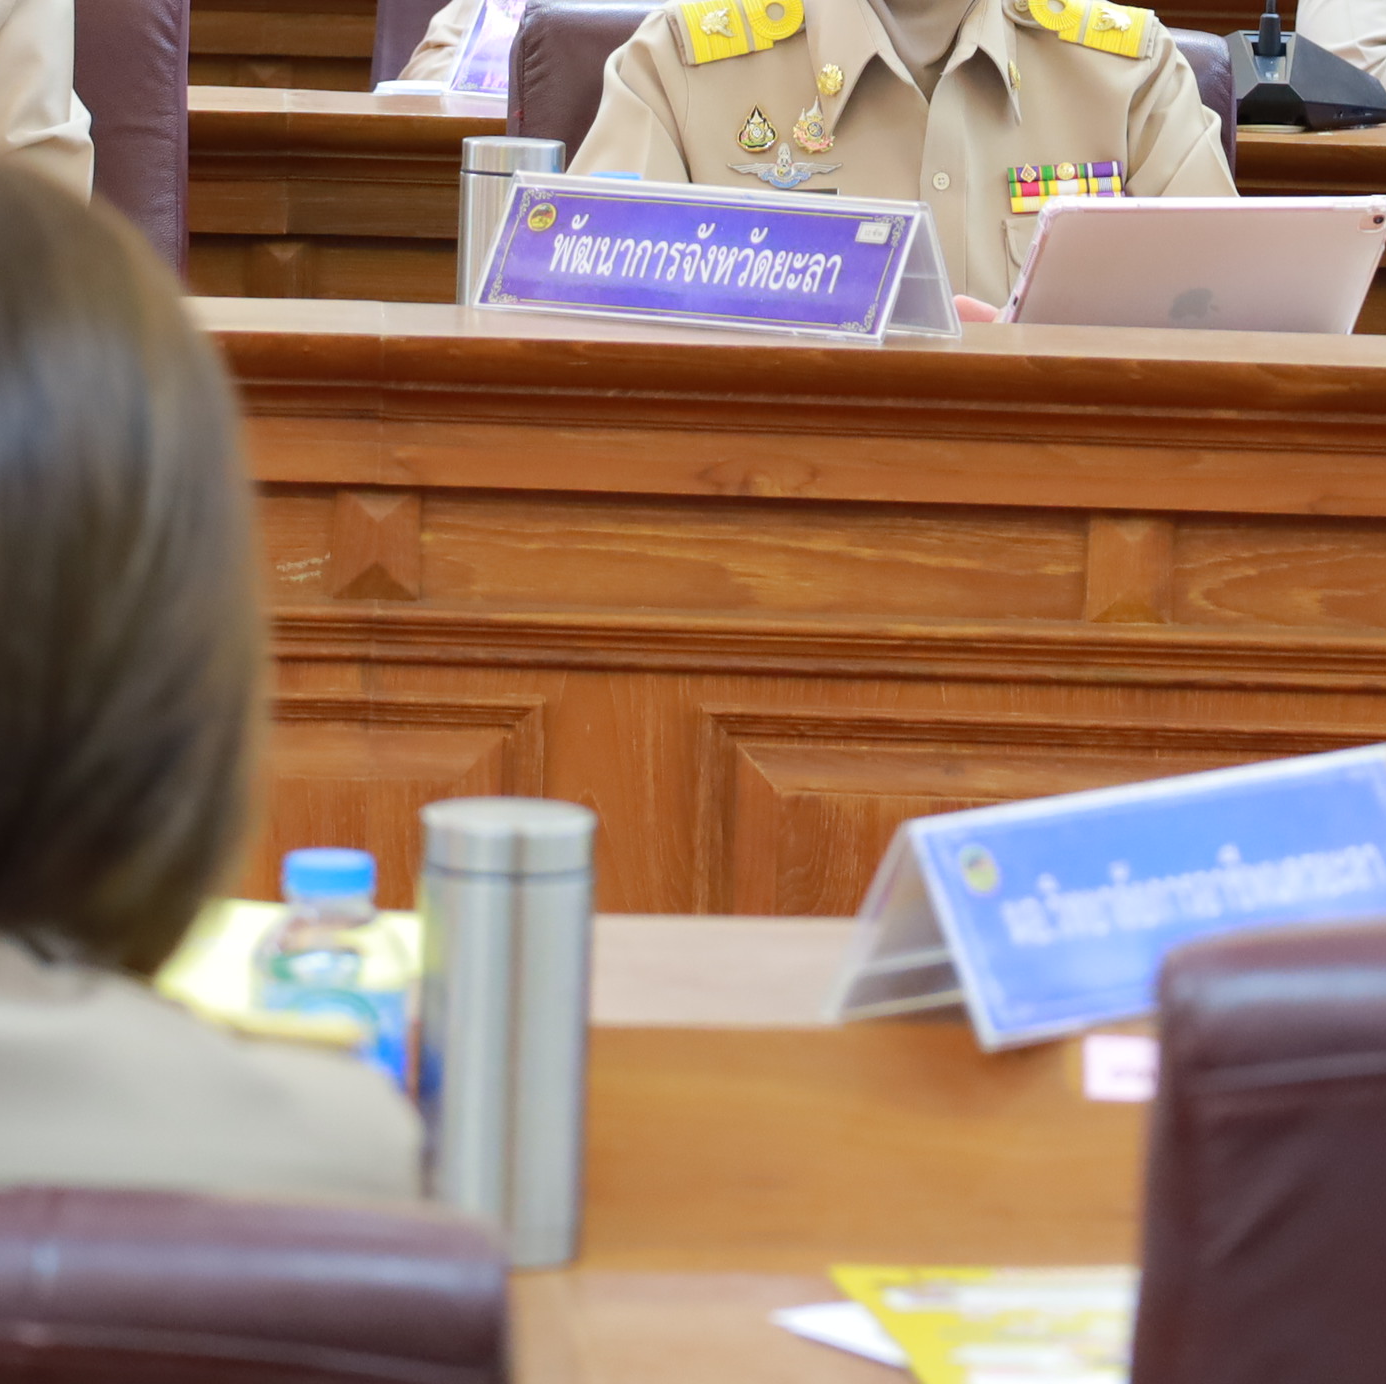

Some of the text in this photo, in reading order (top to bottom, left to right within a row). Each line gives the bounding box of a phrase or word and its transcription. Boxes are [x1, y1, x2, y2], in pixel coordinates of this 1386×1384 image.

[549, 213, 843, 295] พัฒนาการจังหวัดยะลา
